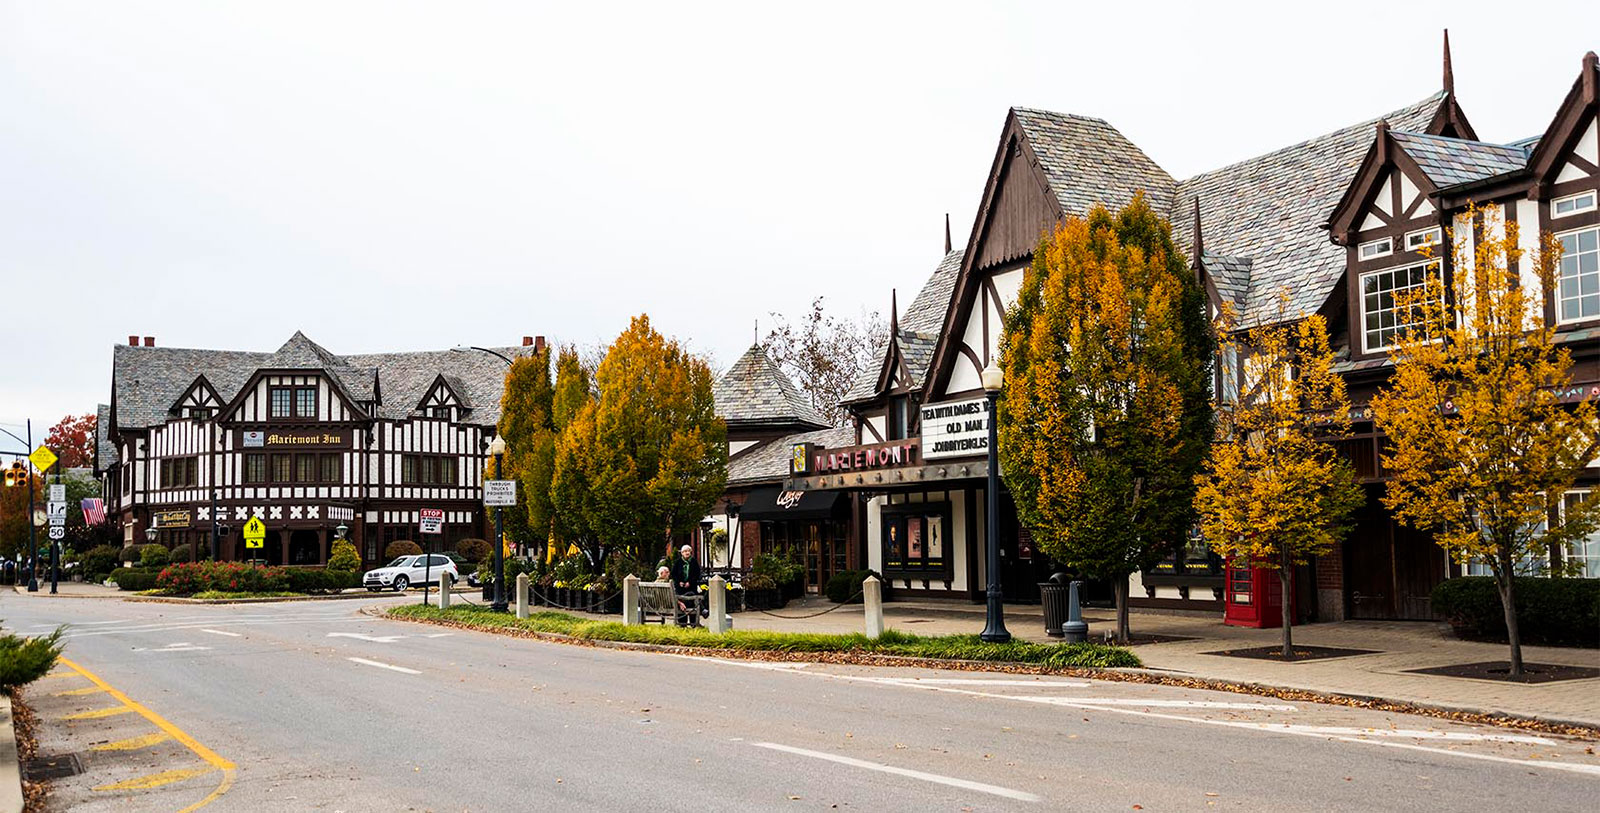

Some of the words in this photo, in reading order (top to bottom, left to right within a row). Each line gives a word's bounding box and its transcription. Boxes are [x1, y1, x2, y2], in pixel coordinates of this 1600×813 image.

[921, 409, 935, 421] TEA
[935, 405, 953, 419] WITH
[954, 402, 980, 417] DAMES
[946, 422, 961, 434] OLD
[965, 419, 982, 432] MAN
[267, 434, 319, 445] Mariemont
[321, 433, 341, 444] Inn
[814, 444, 911, 472] MARIEMONT
[51, 528, 63, 536] 50
